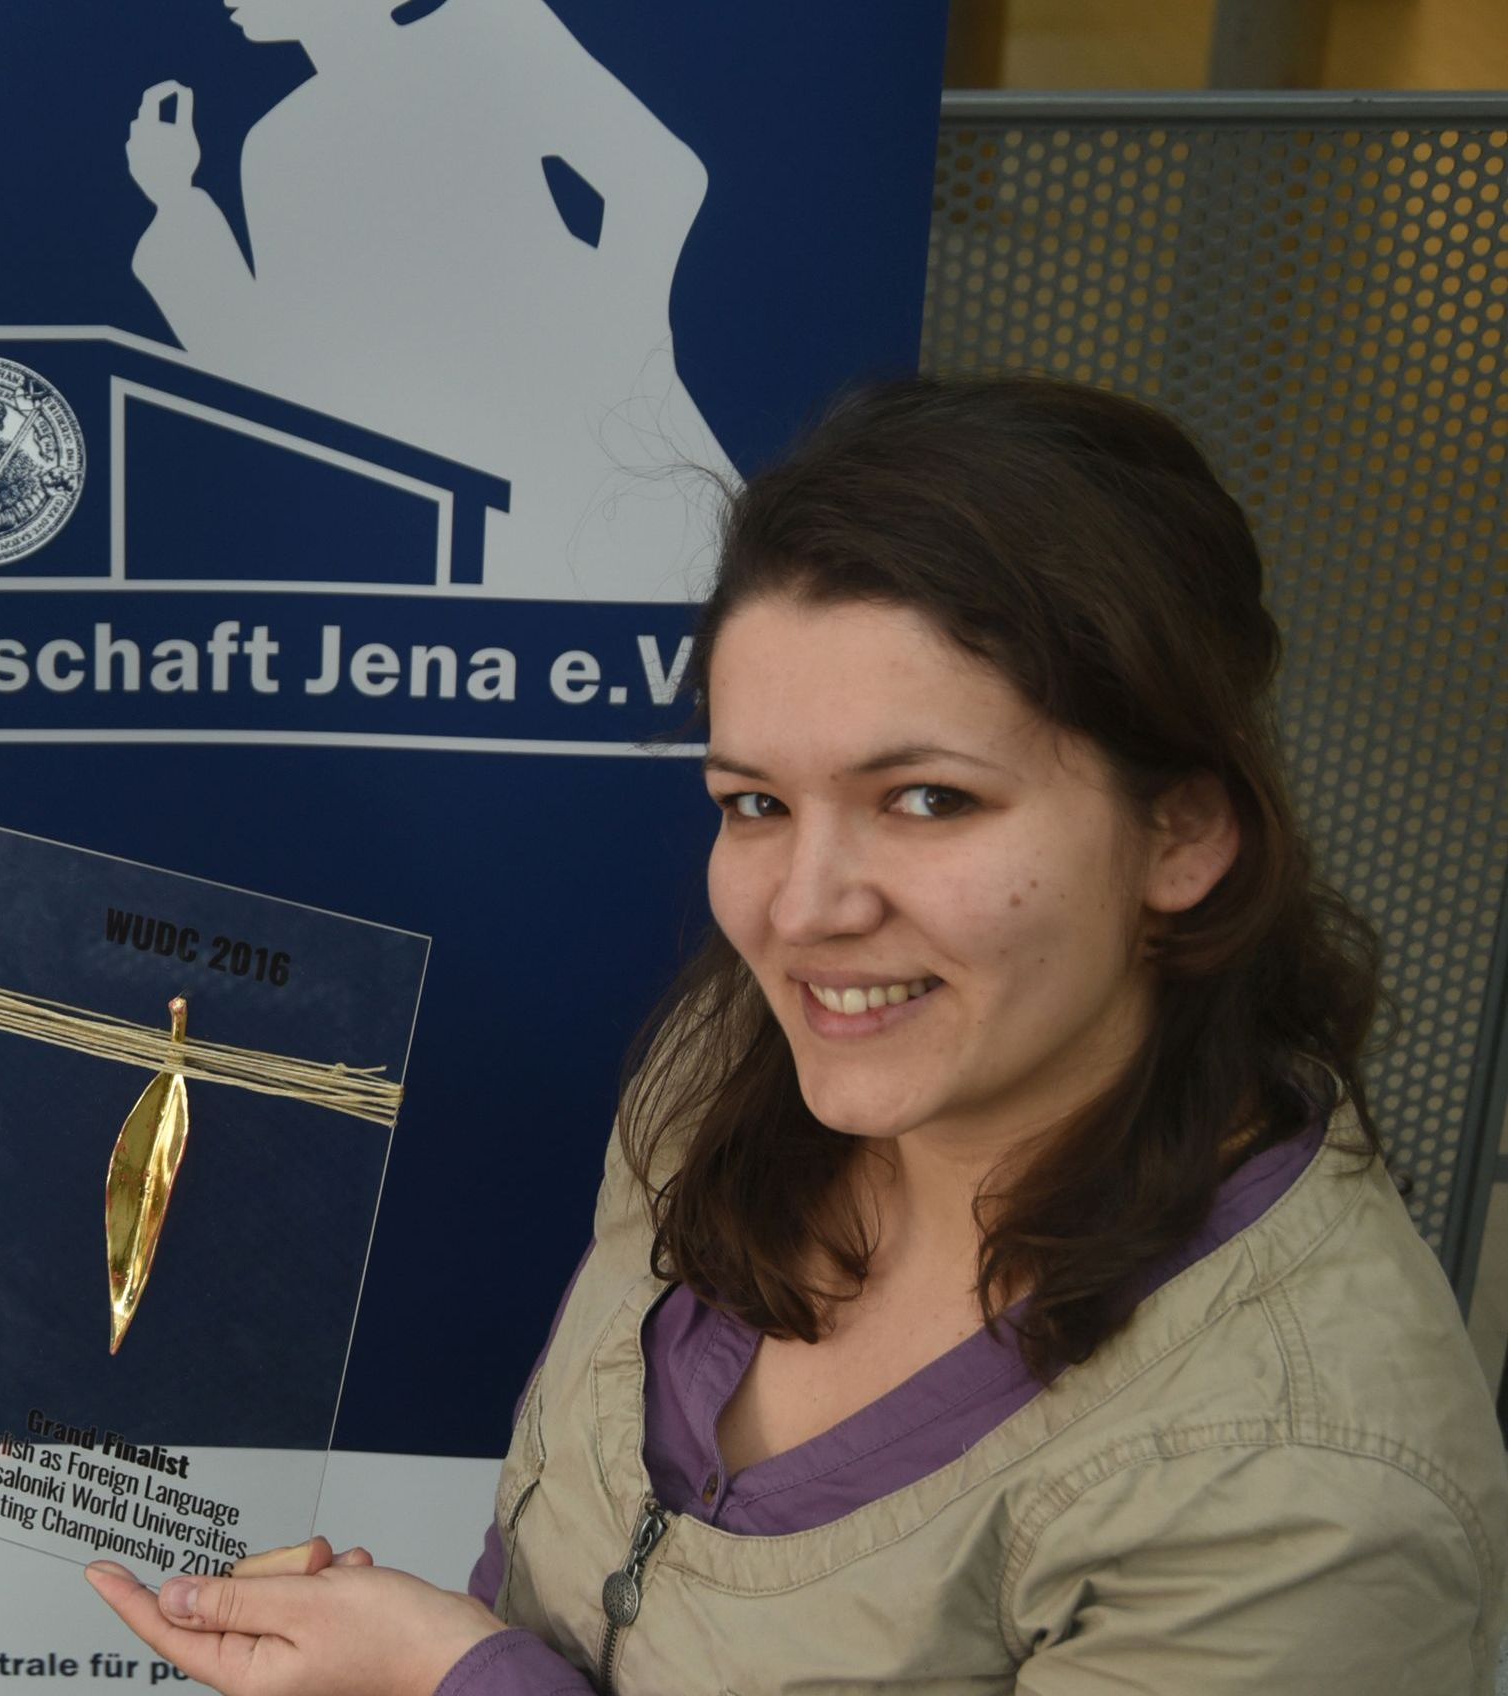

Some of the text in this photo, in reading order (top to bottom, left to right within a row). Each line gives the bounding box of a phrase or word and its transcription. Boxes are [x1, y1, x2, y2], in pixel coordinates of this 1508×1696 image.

[305, 625, 516, 701] Jena
[550, 634, 700, 706] e.V
[104, 906, 292, 987] WUDC 2016
[27, 1408, 190, 1479] Grand Finalist
[40, 1449, 62, 1471] as
[67, 1452, 139, 1496] Foreign
[144, 1474, 240, 1526] Language
[72, 1484, 128, 1523] World
[132, 1502, 248, 1560] Universities
[41, 1505, 175, 1572] Championship
[90, 1652, 138, 1679] für
